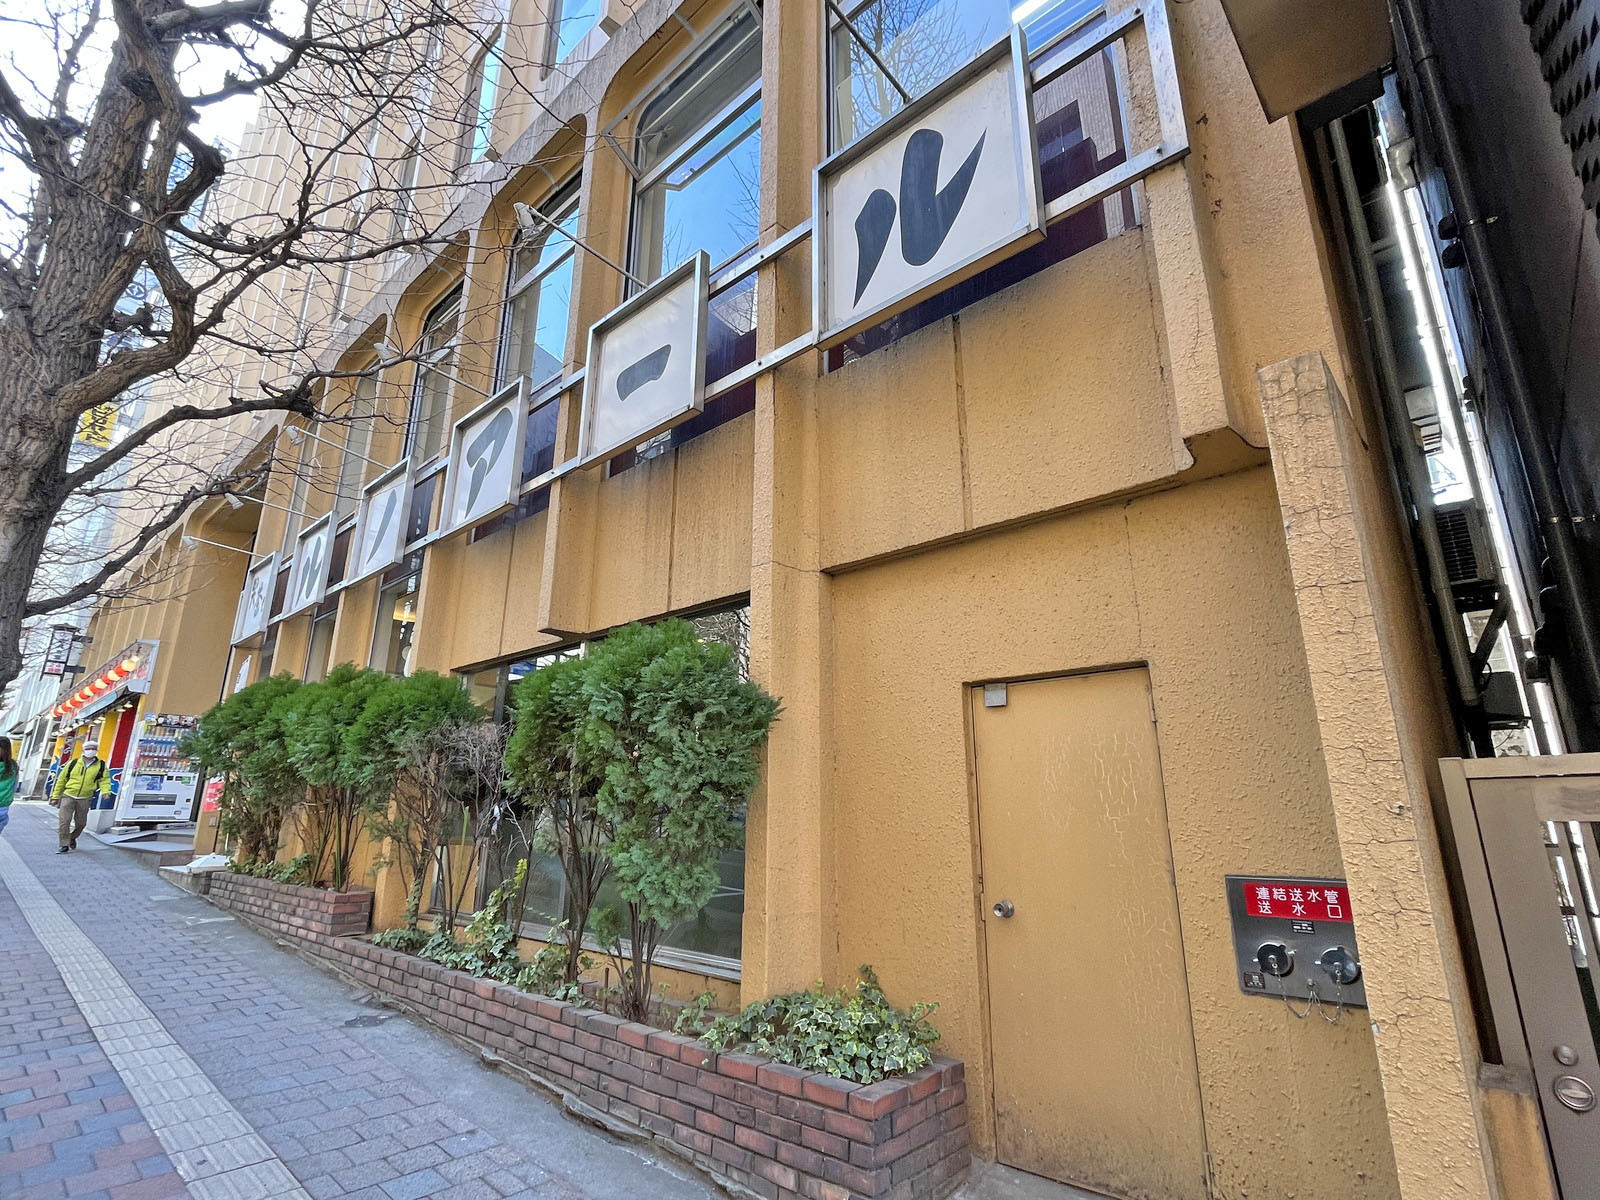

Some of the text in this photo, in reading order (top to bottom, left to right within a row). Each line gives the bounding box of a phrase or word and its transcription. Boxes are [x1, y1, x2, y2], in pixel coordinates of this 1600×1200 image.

[295, 128, 986, 607] ルノアール
[1256, 887, 1339, 904] 連結送水管
[1258, 902, 1342, 918] 送水口
